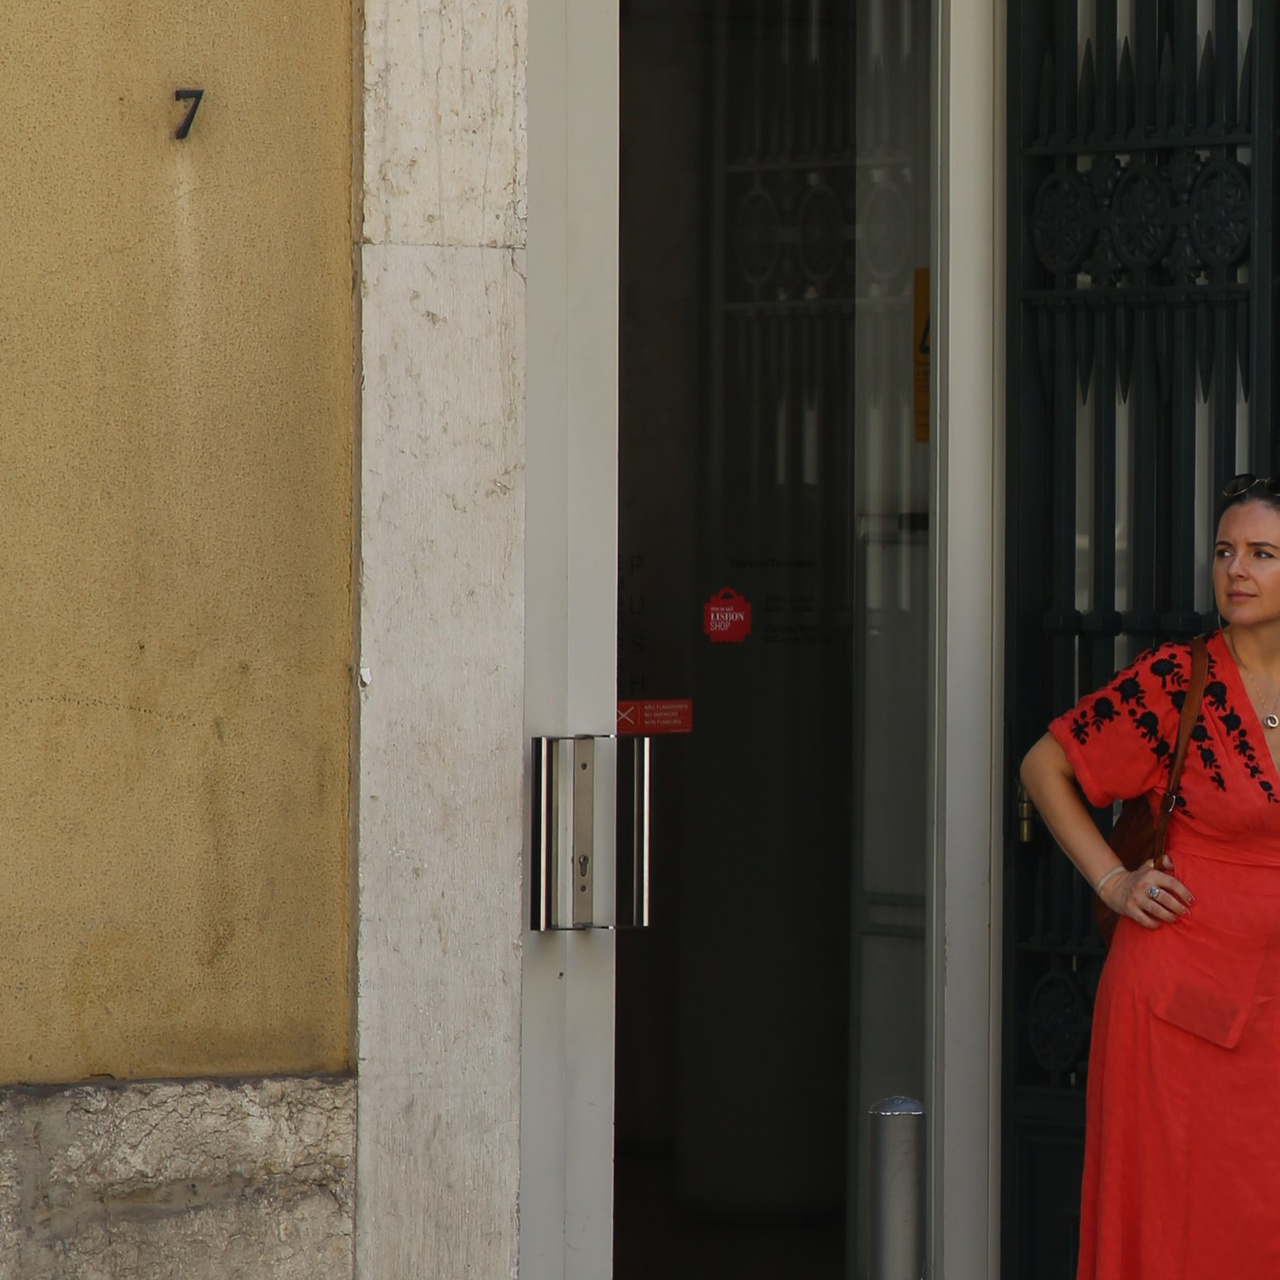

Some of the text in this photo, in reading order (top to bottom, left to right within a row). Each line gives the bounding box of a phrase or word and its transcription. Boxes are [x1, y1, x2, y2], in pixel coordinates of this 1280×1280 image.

[175, 89, 205, 140] 7
[711, 612, 744, 621] LISBON
[710, 621, 731, 631] SHOP
